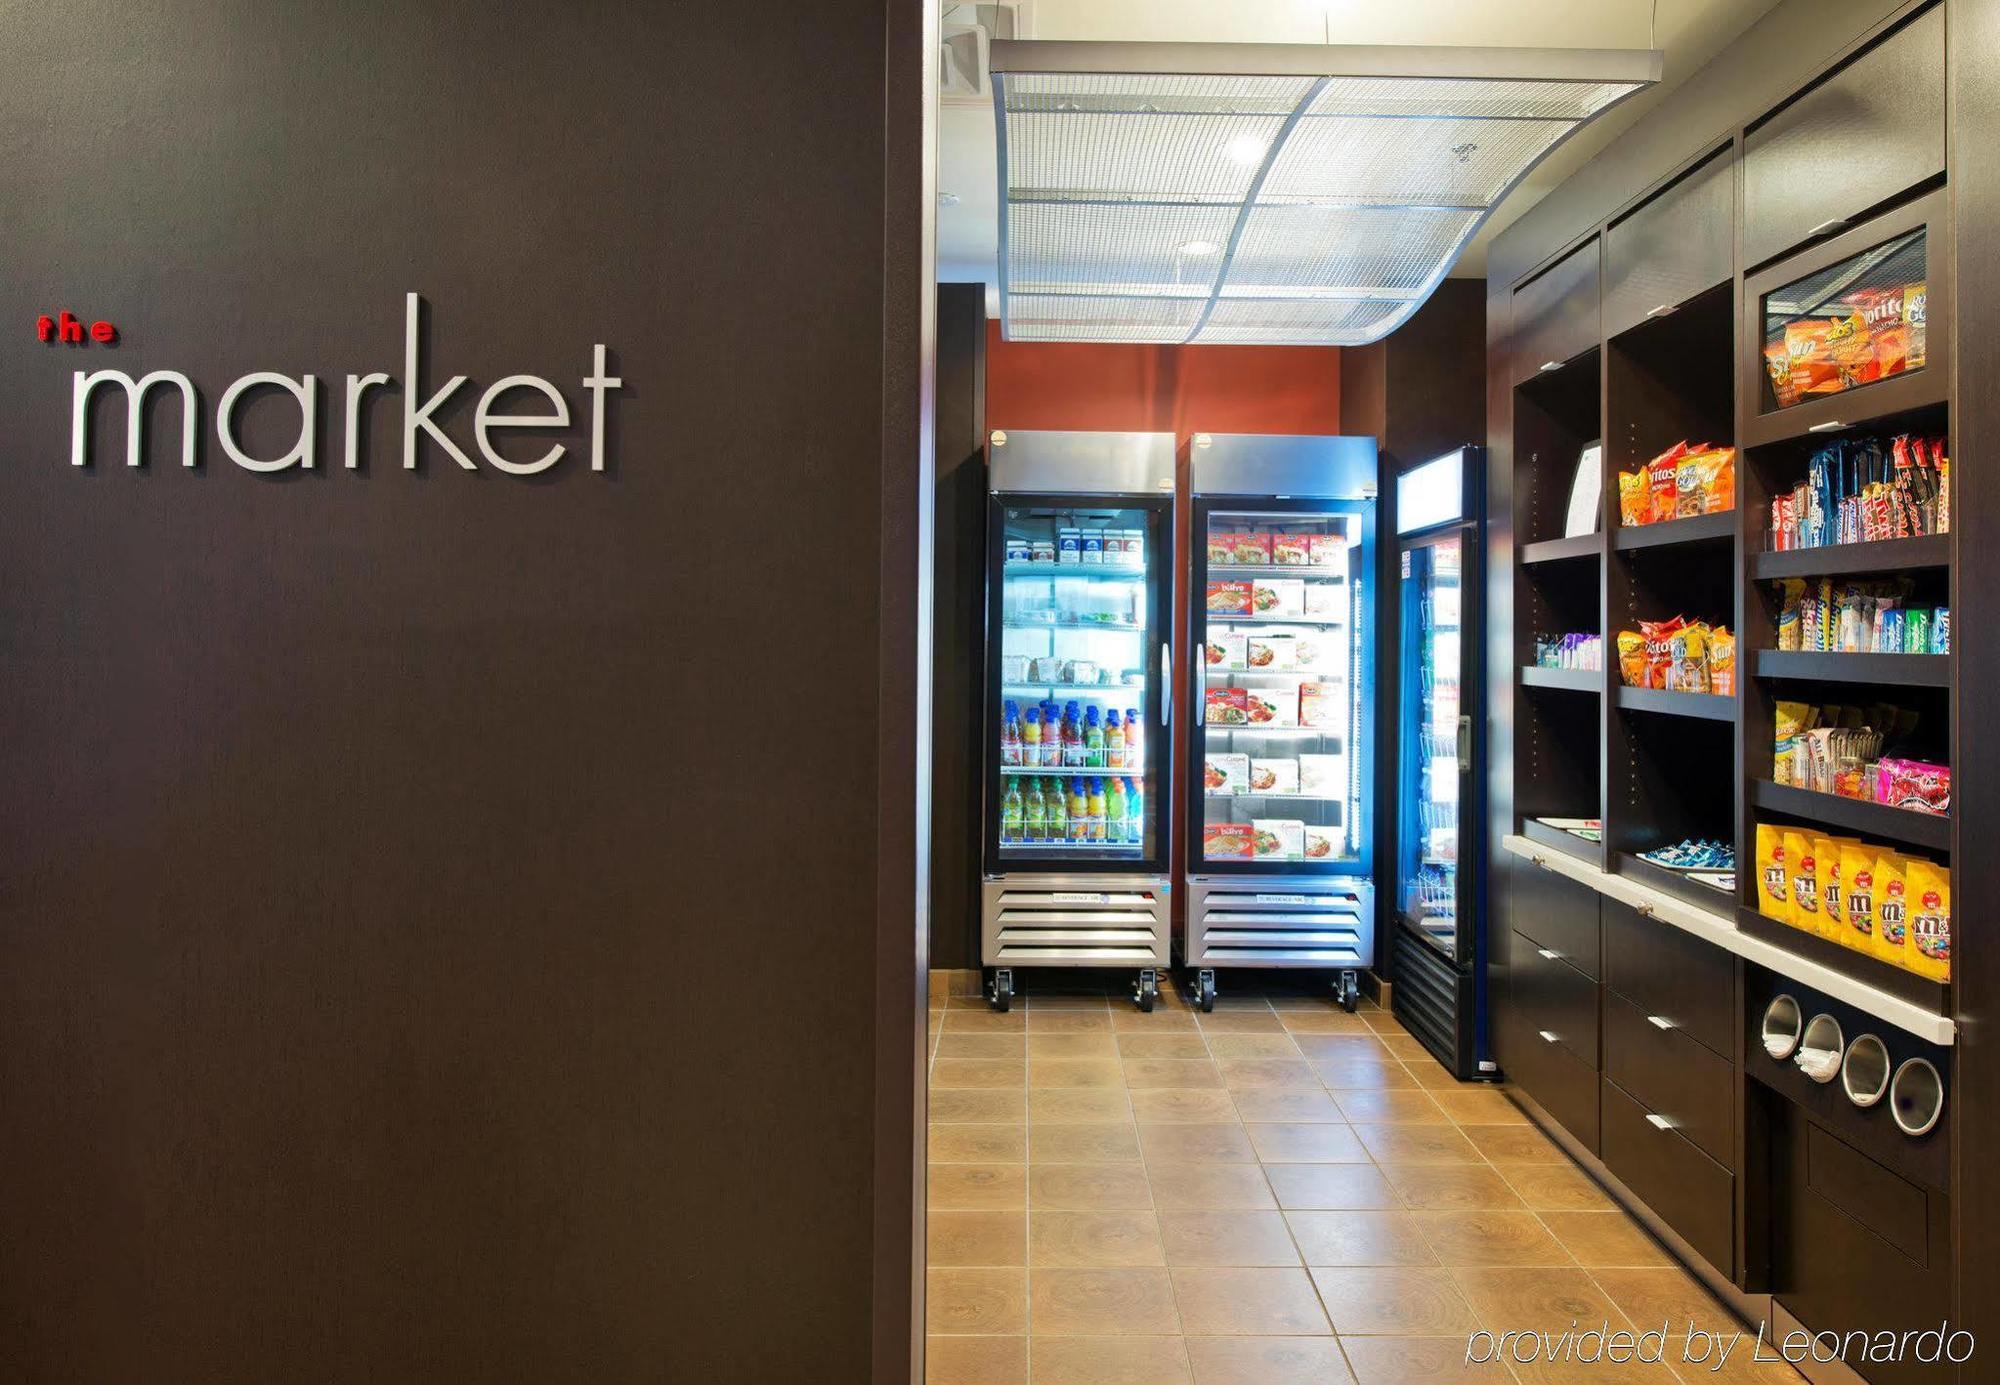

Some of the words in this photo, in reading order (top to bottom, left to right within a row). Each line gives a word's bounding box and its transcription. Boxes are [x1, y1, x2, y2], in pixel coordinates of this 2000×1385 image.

[37, 311, 115, 344] the
[71, 292, 623, 475] market
[1651, 468, 1676, 482] ritos
